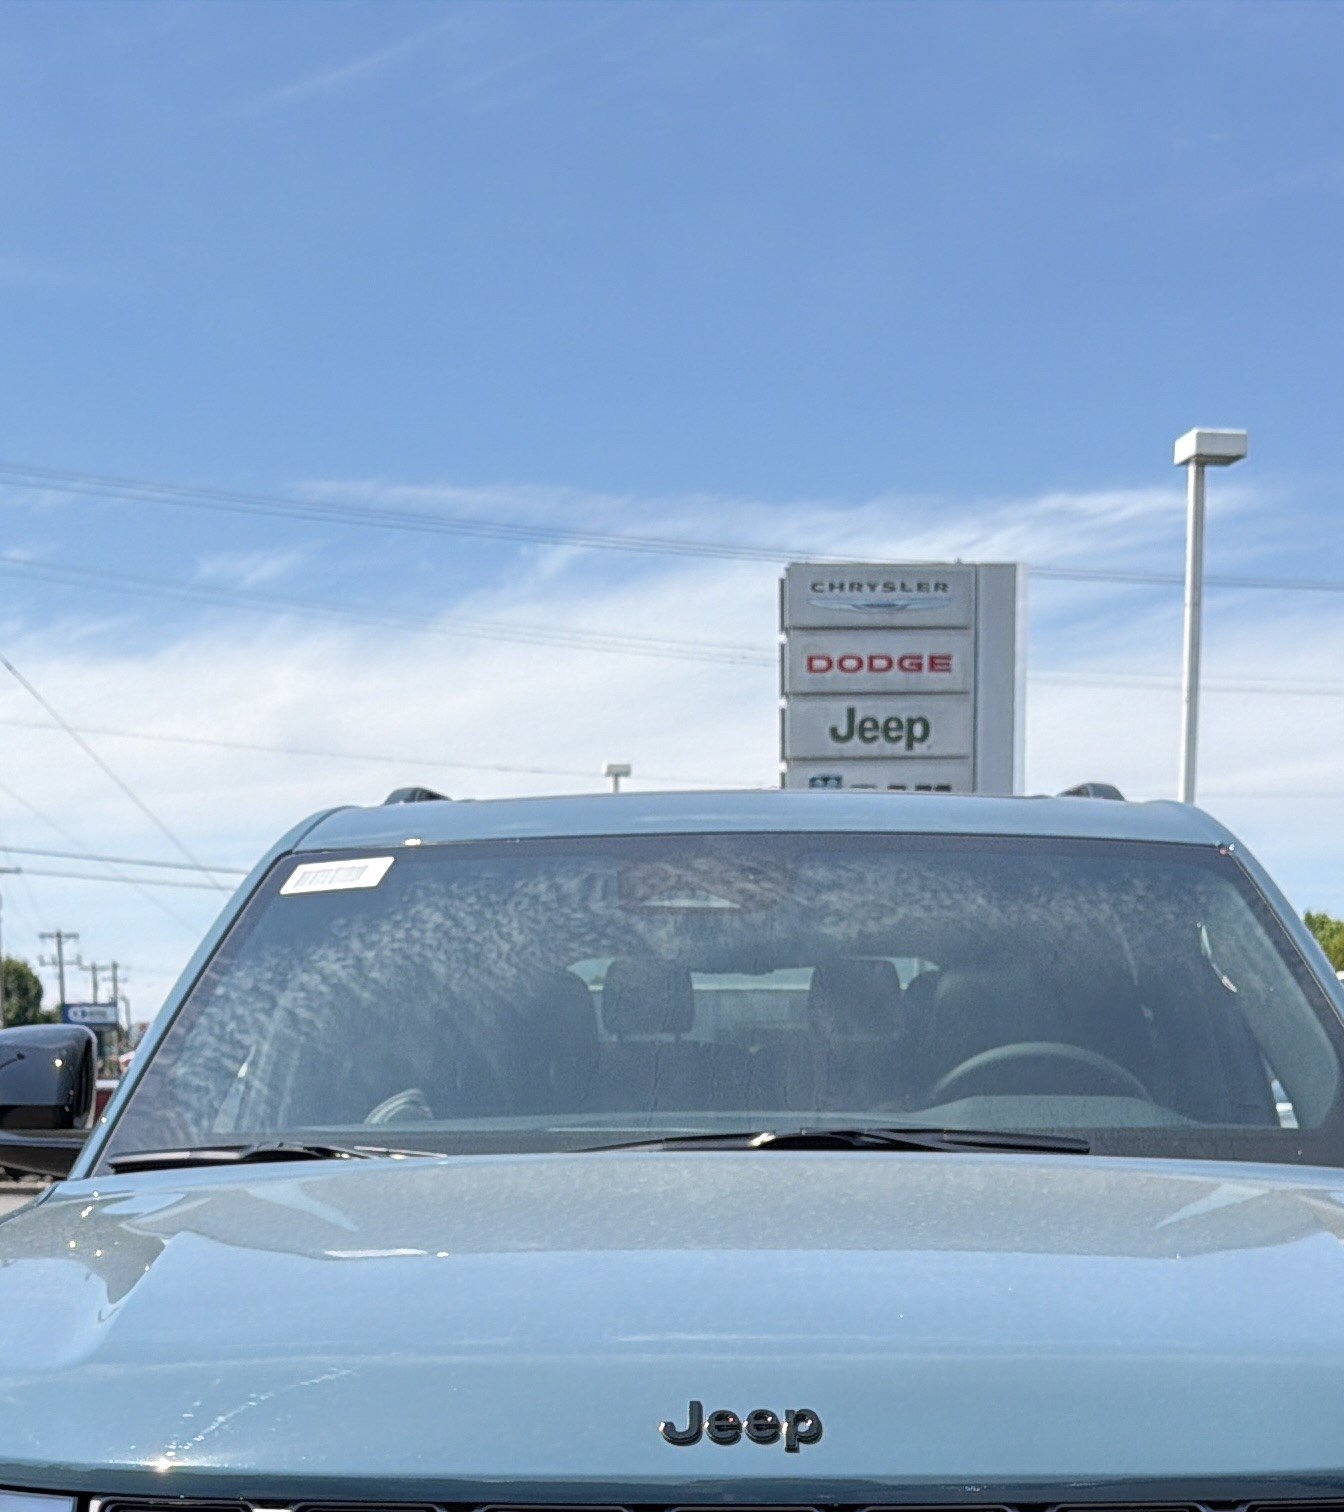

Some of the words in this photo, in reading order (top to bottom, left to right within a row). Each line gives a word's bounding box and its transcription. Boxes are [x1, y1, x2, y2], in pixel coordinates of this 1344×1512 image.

[811, 581, 949, 593] CHRYSLER
[807, 654, 952, 673] DODGE
[829, 707, 930, 751] Jeep
[659, 1400, 823, 1453] Jeep
